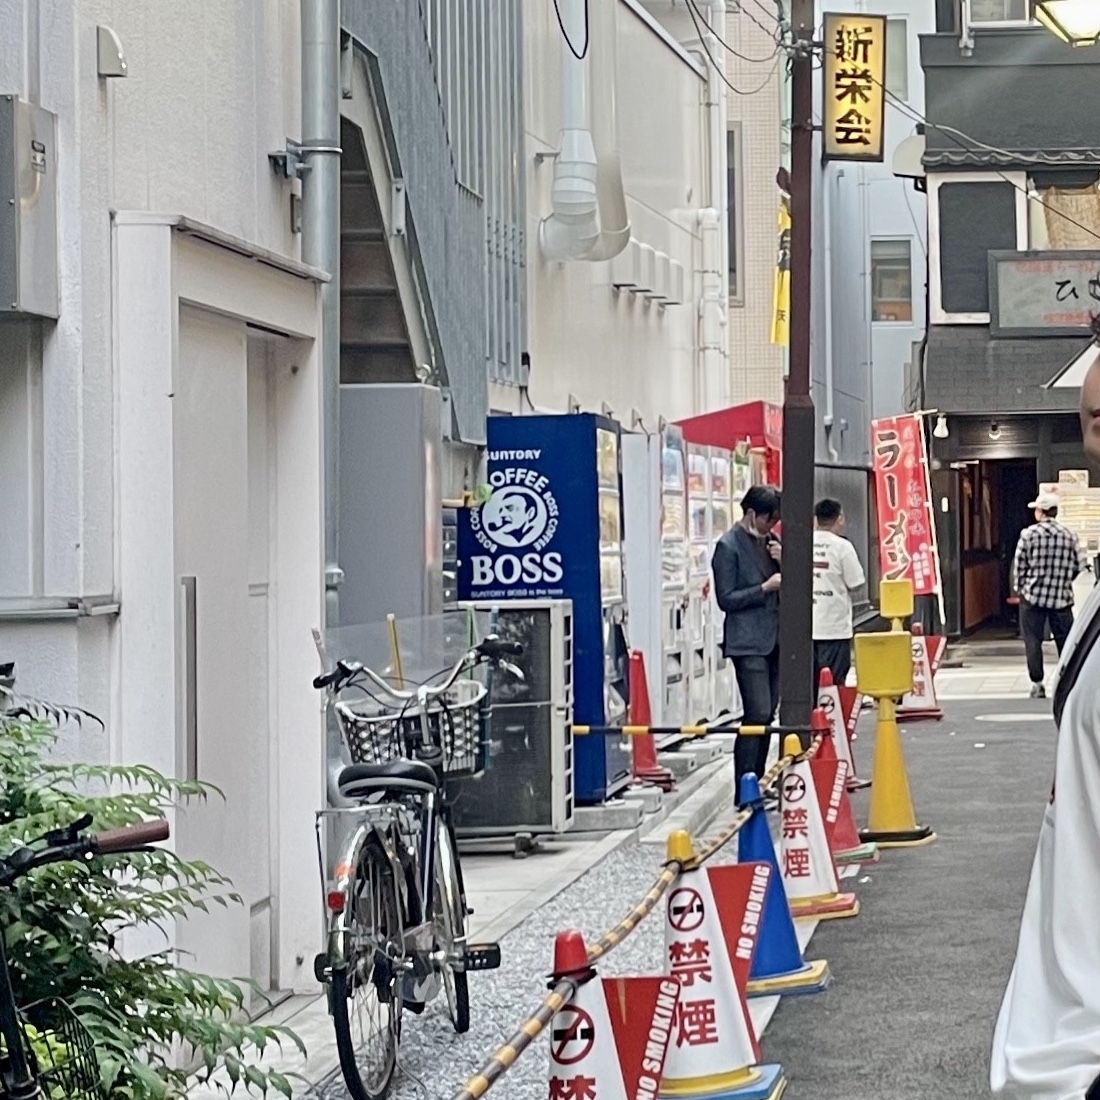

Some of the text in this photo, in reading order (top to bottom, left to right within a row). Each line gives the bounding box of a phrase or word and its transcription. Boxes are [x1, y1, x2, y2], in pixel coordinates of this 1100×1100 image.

[835, 25, 873, 146] 新栄会
[489, 467, 549, 493] OFFEE
[876, 430, 912, 581] ラーメン
[470, 552, 563, 586] BOSS
[826, 760, 848, 824] NO SMOKING
[783, 808, 811, 879] 禁煙
[735, 864, 771, 960] NO SMOKING
[644, 980, 679, 1073] SMOKING
[668, 938, 719, 1049] 禁煙
